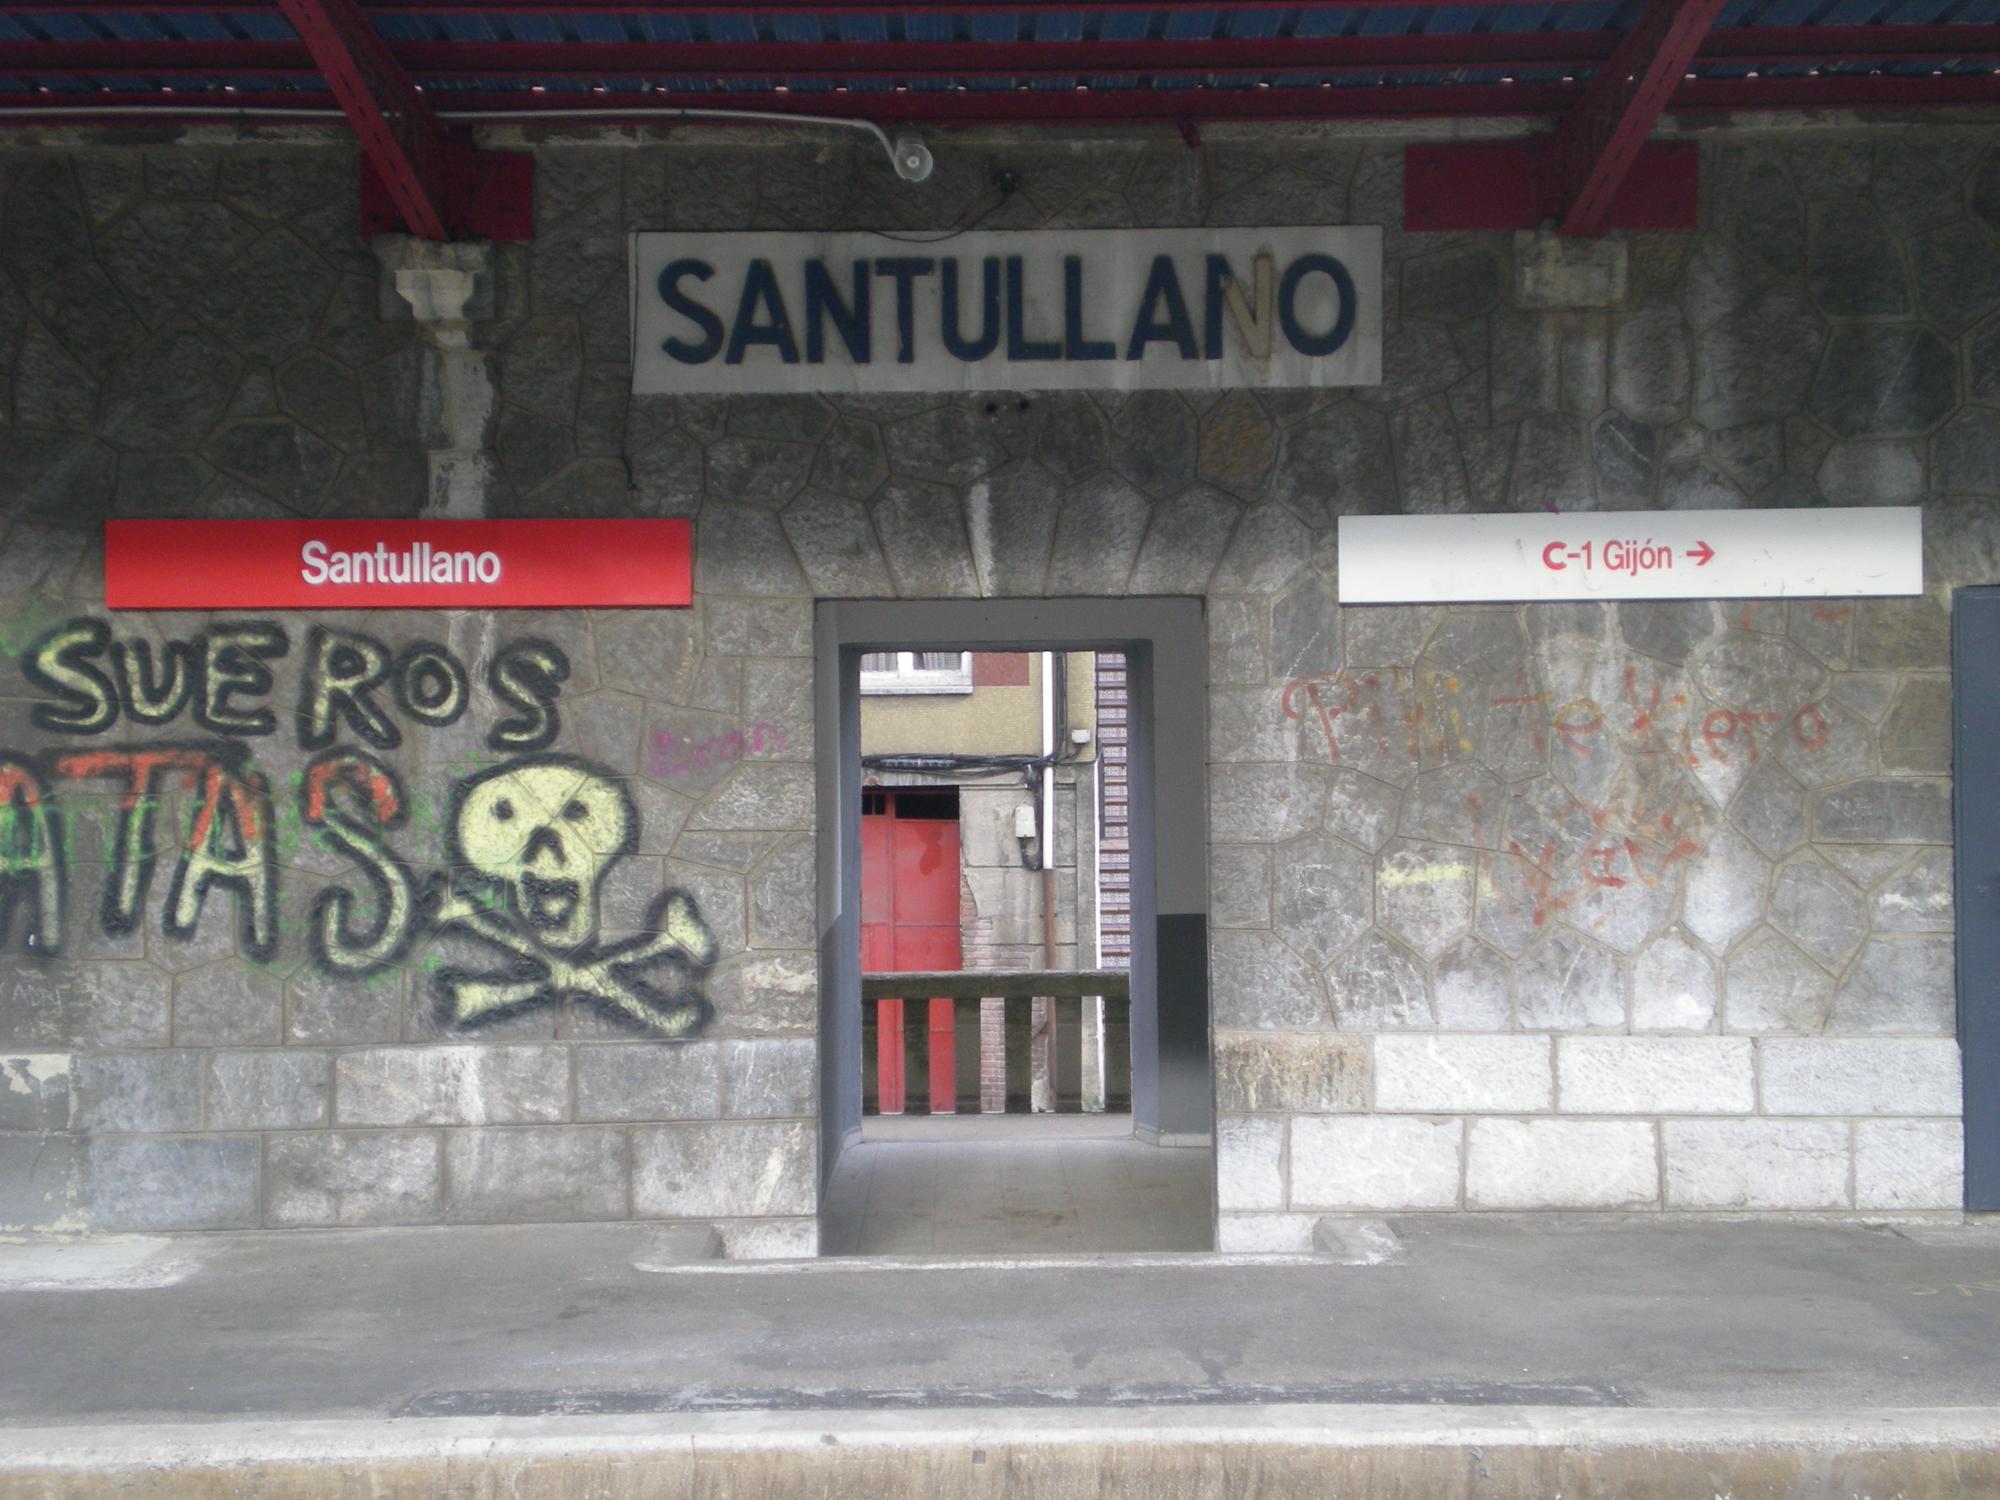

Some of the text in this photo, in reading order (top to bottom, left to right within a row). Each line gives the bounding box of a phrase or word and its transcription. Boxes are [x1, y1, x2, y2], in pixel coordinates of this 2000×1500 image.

[657, 253, 1358, 364] SANTULLANO
[301, 540, 501, 584] Santullano
[1542, 538, 1673, 576] C-1 Gijón
[22, 615, 570, 752] SUEROS
